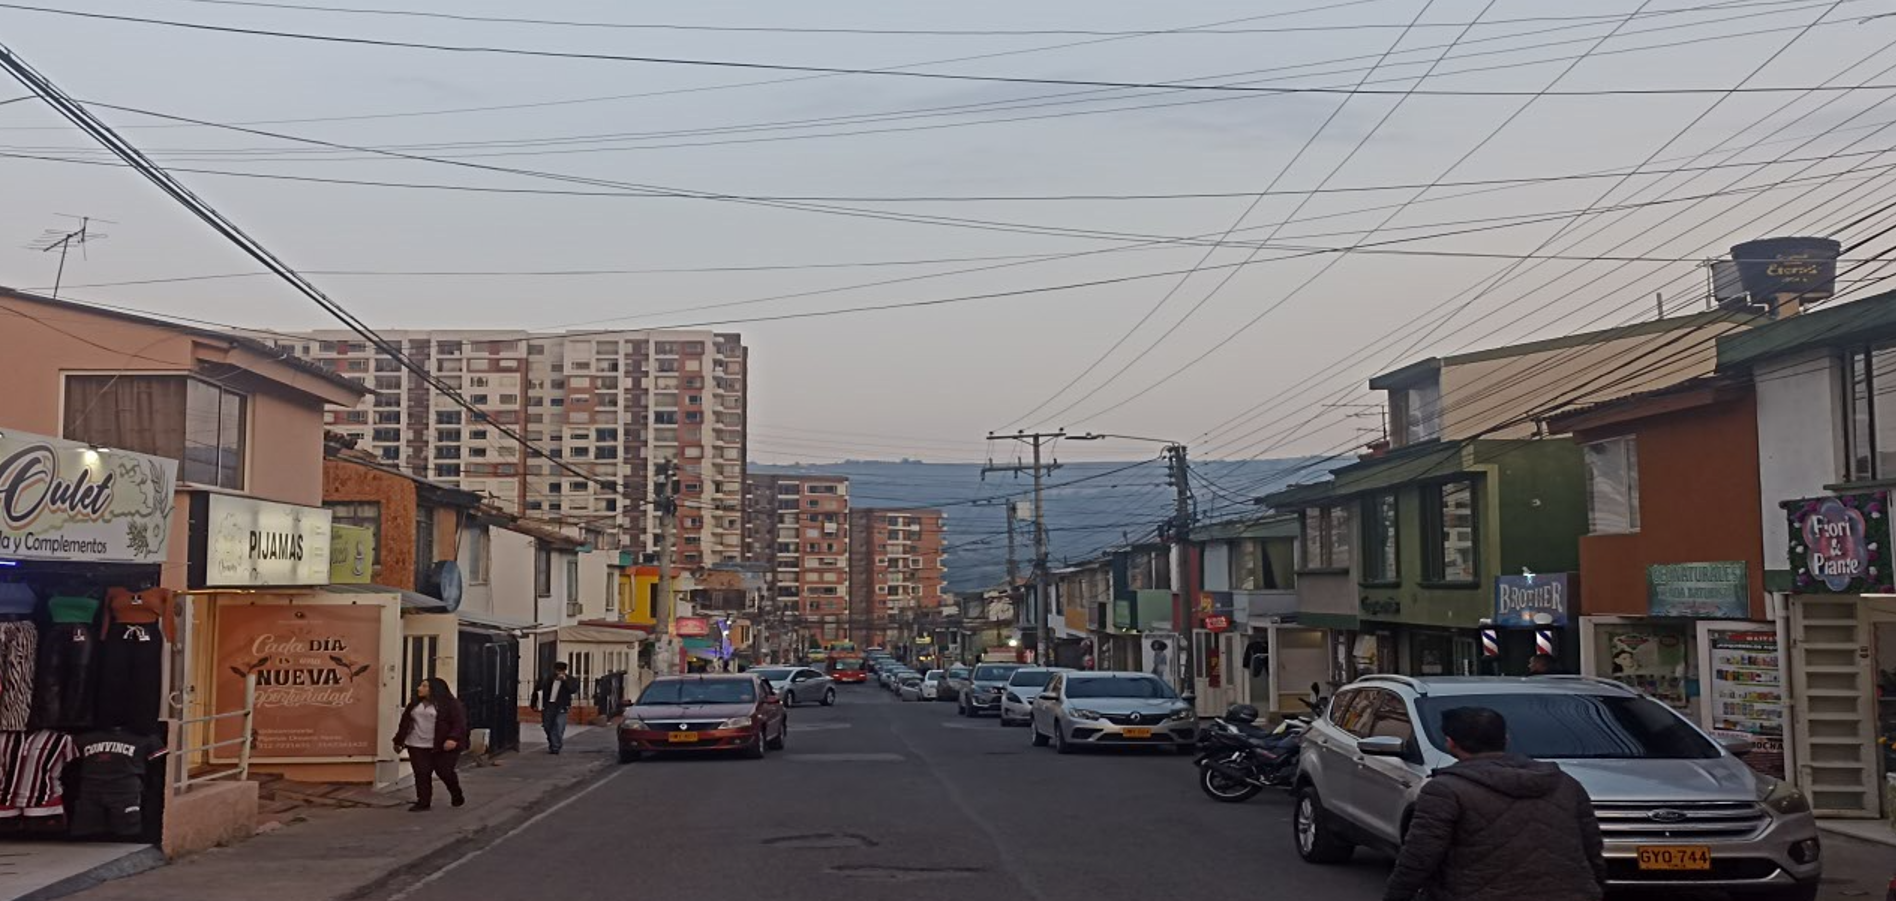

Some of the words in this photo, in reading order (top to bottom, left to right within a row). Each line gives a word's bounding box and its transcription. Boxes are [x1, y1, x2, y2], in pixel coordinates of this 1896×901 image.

[1812, 515, 1851, 537] Fiori
[13, 537, 22, 553] y
[25, 532, 107, 554] Complementos
[248, 530, 304, 562] PIJAMAS
[1830, 538, 1843, 556] &
[1813, 553, 1859, 575] Piante
[1499, 582, 1563, 613] BROTHER
[252, 633, 305, 656] Cada
[309, 636, 347, 652] DÍA
[256, 668, 342, 686] NUEVA
[254, 687, 353, 708] oportunidad
[84, 741, 136, 758] CONVINCE
